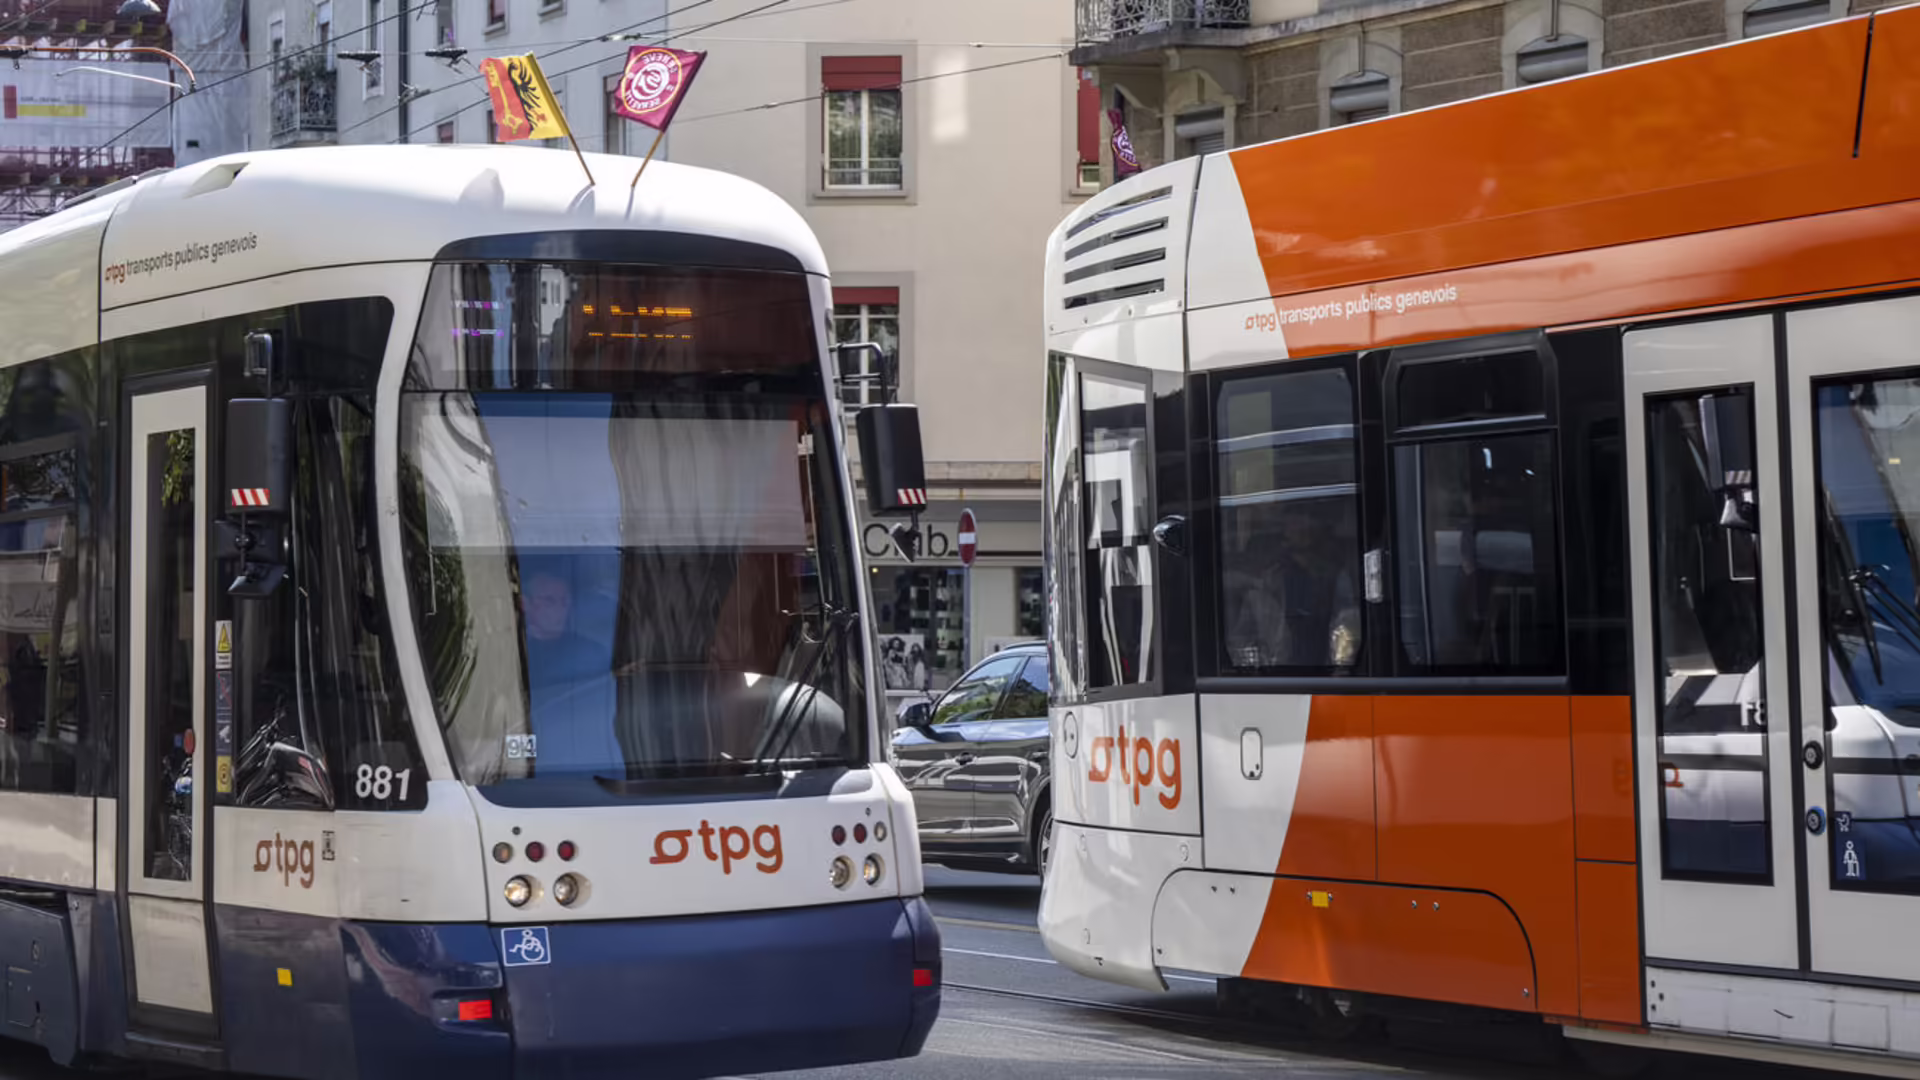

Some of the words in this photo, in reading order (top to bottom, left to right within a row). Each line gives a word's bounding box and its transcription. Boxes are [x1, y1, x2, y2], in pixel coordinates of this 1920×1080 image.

[126, 251, 173, 277] transports
[174, 242, 210, 271] publics
[211, 232, 258, 263] genevois
[1279, 301, 1343, 325] transports
[1345, 293, 1393, 320] publics
[1395, 283, 1458, 313] genevois
[355, 763, 411, 801] 881
